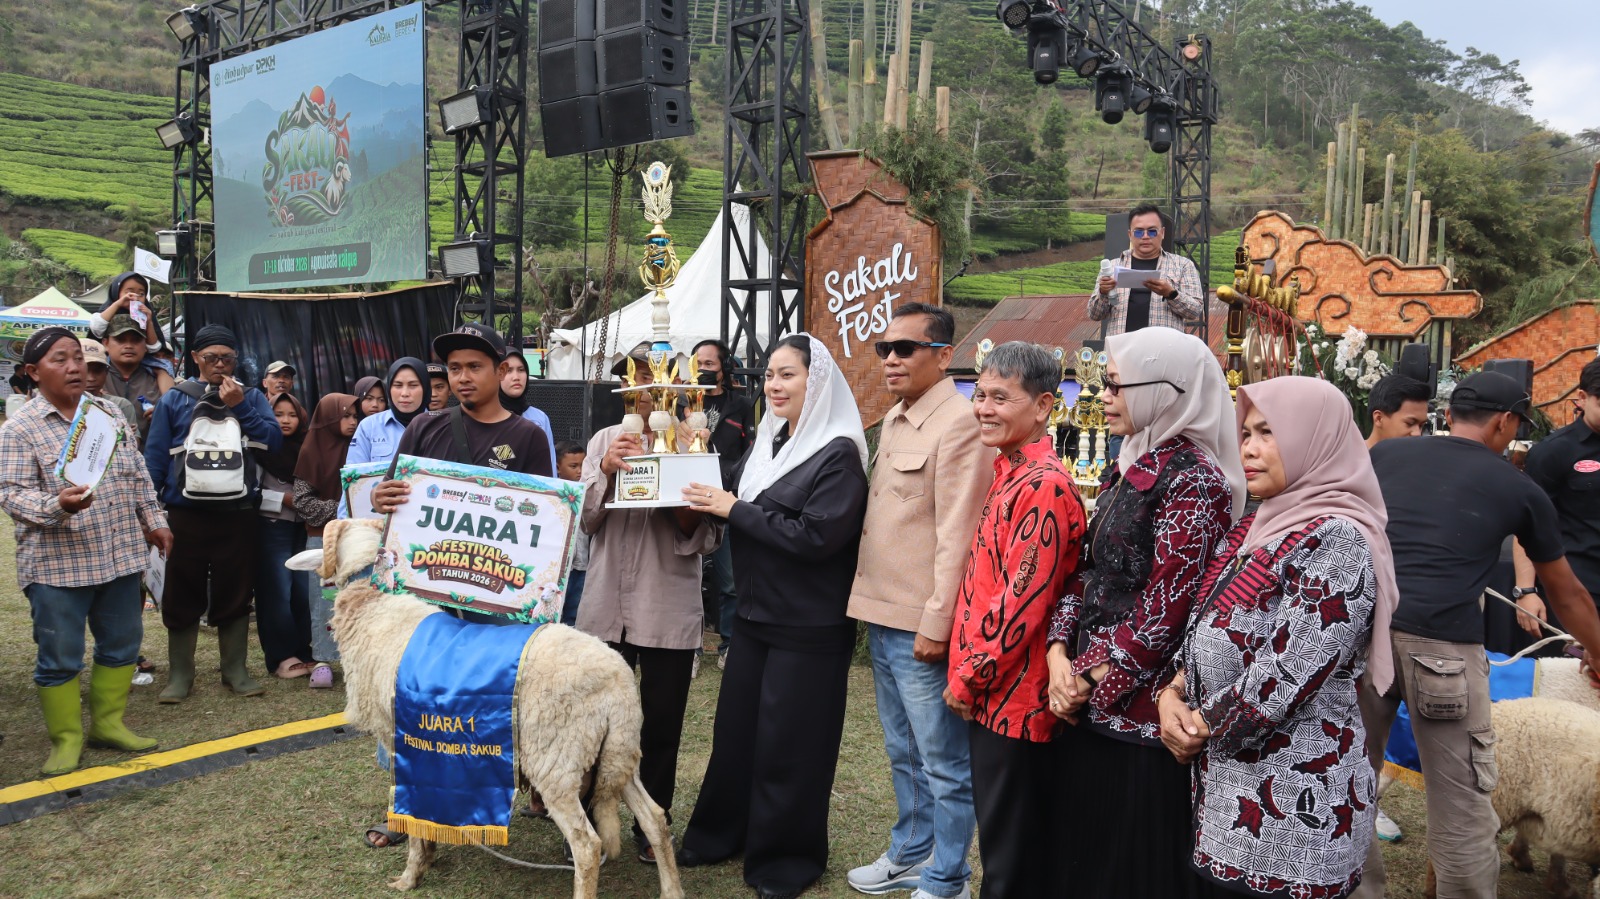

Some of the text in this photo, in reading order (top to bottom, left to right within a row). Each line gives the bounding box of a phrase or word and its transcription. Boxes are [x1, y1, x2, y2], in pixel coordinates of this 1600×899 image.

[289, 171, 319, 192] FEST
[824, 242, 918, 313] Sakali
[836, 290, 901, 358] Fest
[650, 466, 654, 474] 1
[416, 505, 519, 545] JUARA
[529, 524, 542, 548] 1
[441, 540, 503, 562] FESTIVAL
[412, 550, 527, 588] DOMBA SAKUB
[441, 568, 490, 585] TAHUN 2026
[418, 713, 475, 732] JUARA 1
[404, 733, 502, 756] FESTIVAL DOMBA SAKUB
